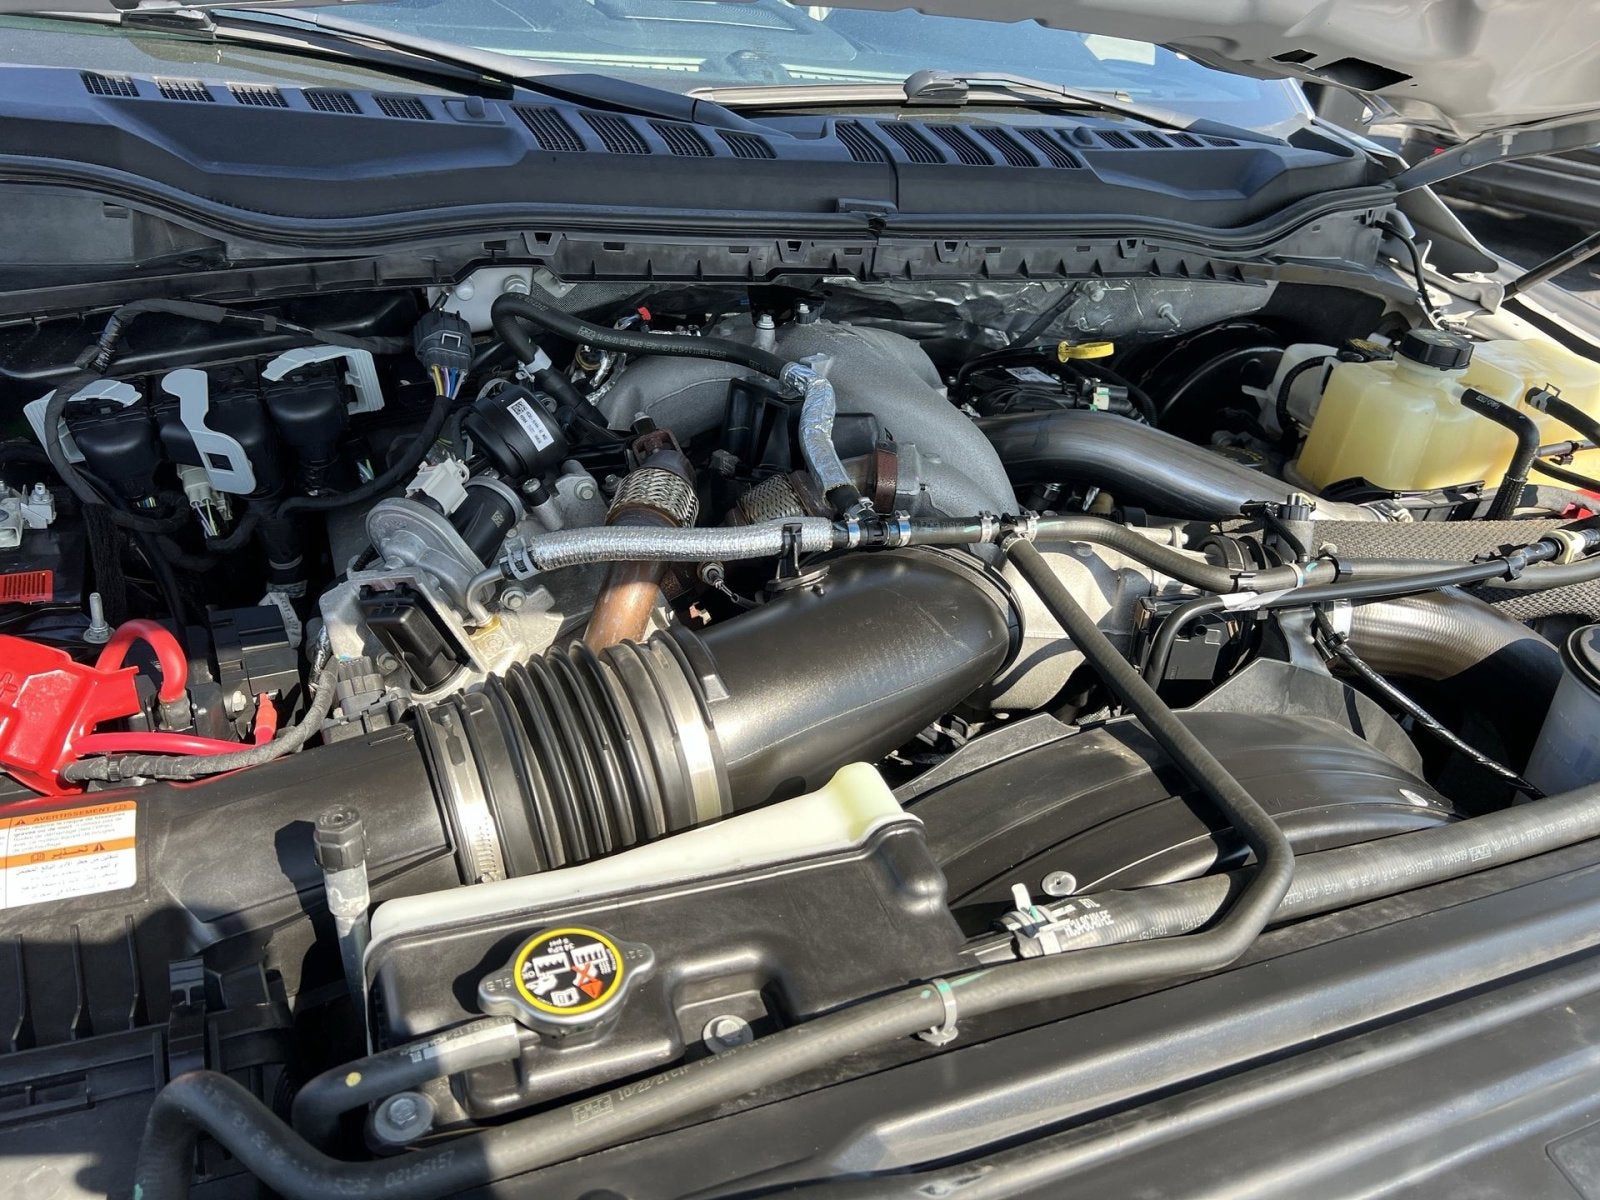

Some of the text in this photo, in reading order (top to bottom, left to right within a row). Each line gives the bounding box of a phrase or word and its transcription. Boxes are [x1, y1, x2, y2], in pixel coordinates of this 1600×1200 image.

[33, 807, 110, 822] AVERTISSEMENT
[51, 845, 88, 860] تحذير
[619, 1073, 669, 1101] 10/22/21
